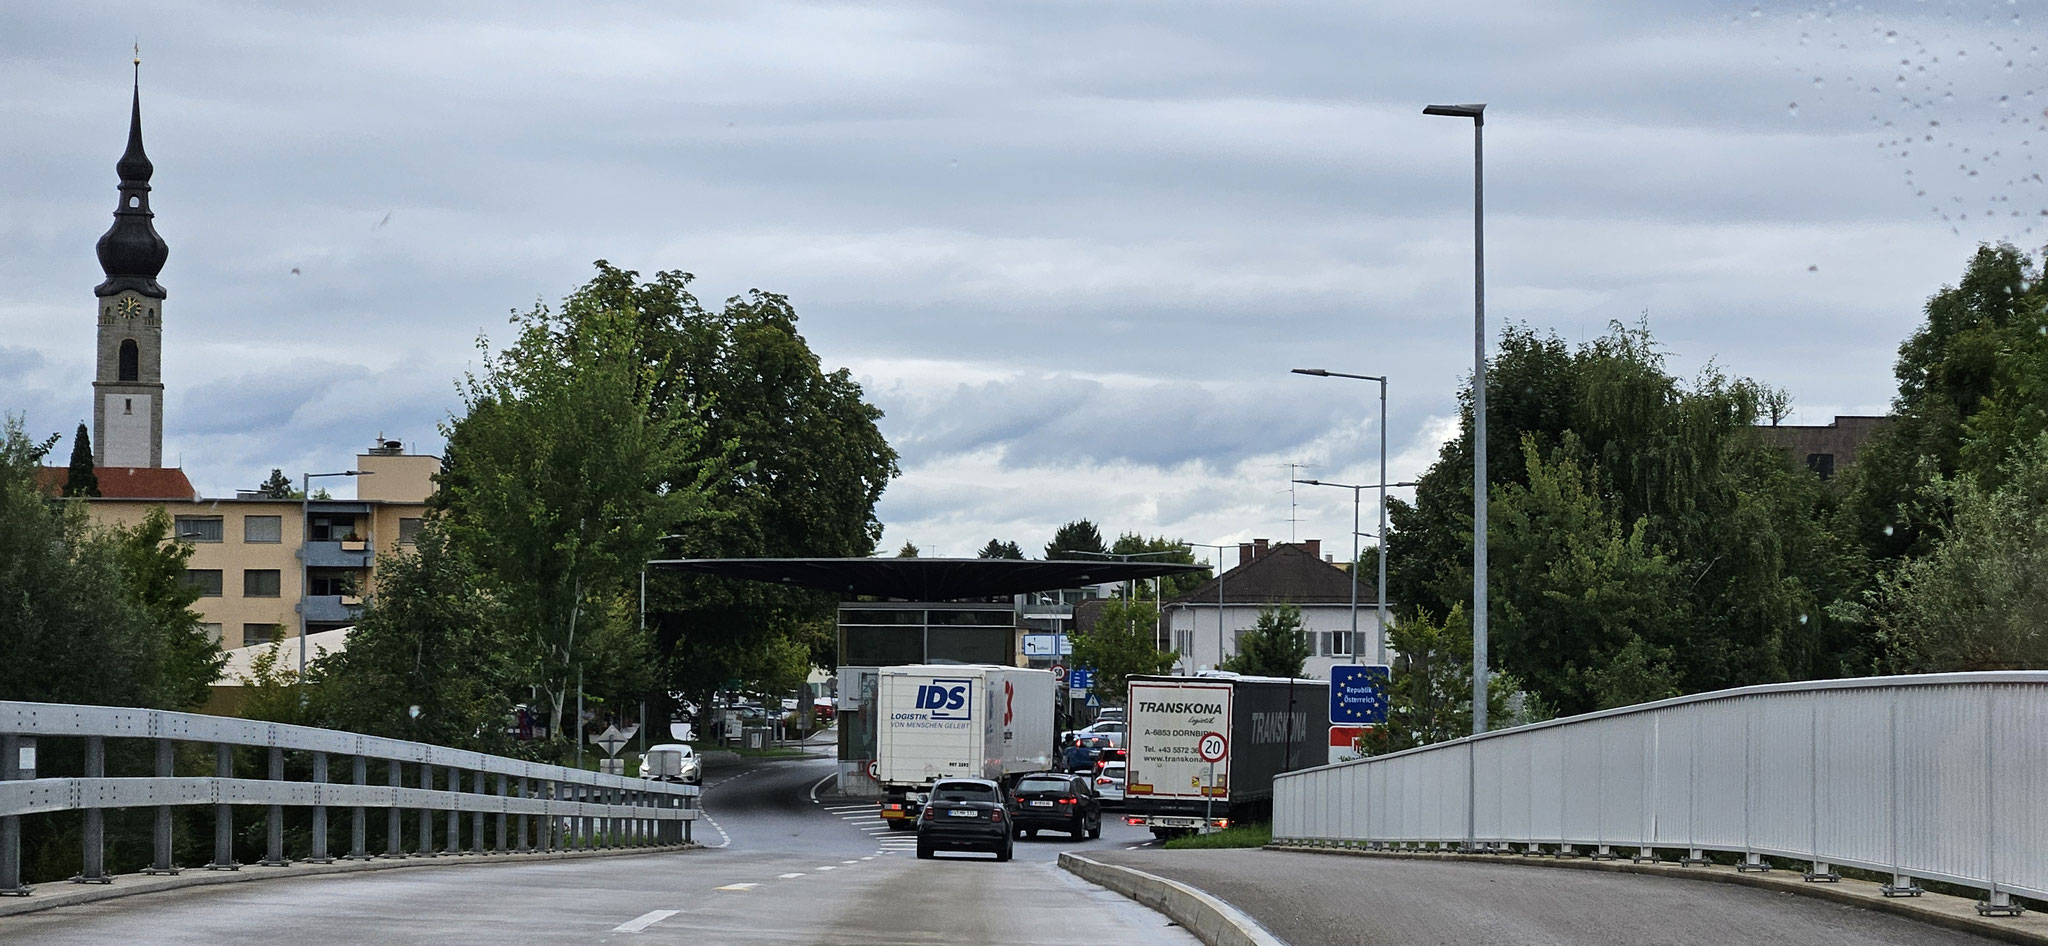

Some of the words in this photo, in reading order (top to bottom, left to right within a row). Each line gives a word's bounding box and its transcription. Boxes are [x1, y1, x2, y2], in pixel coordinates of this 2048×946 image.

[1054, 669, 1063, 677] 50
[1346, 686, 1372, 694] Republik
[916, 685, 966, 710] IDS
[1344, 695, 1375, 703] Österreich
[1139, 702, 1222, 714] TRANSKONA
[944, 722, 970, 730] GELEBT
[1144, 729, 1171, 737] A-6853
[1205, 740, 1221, 754] 20
